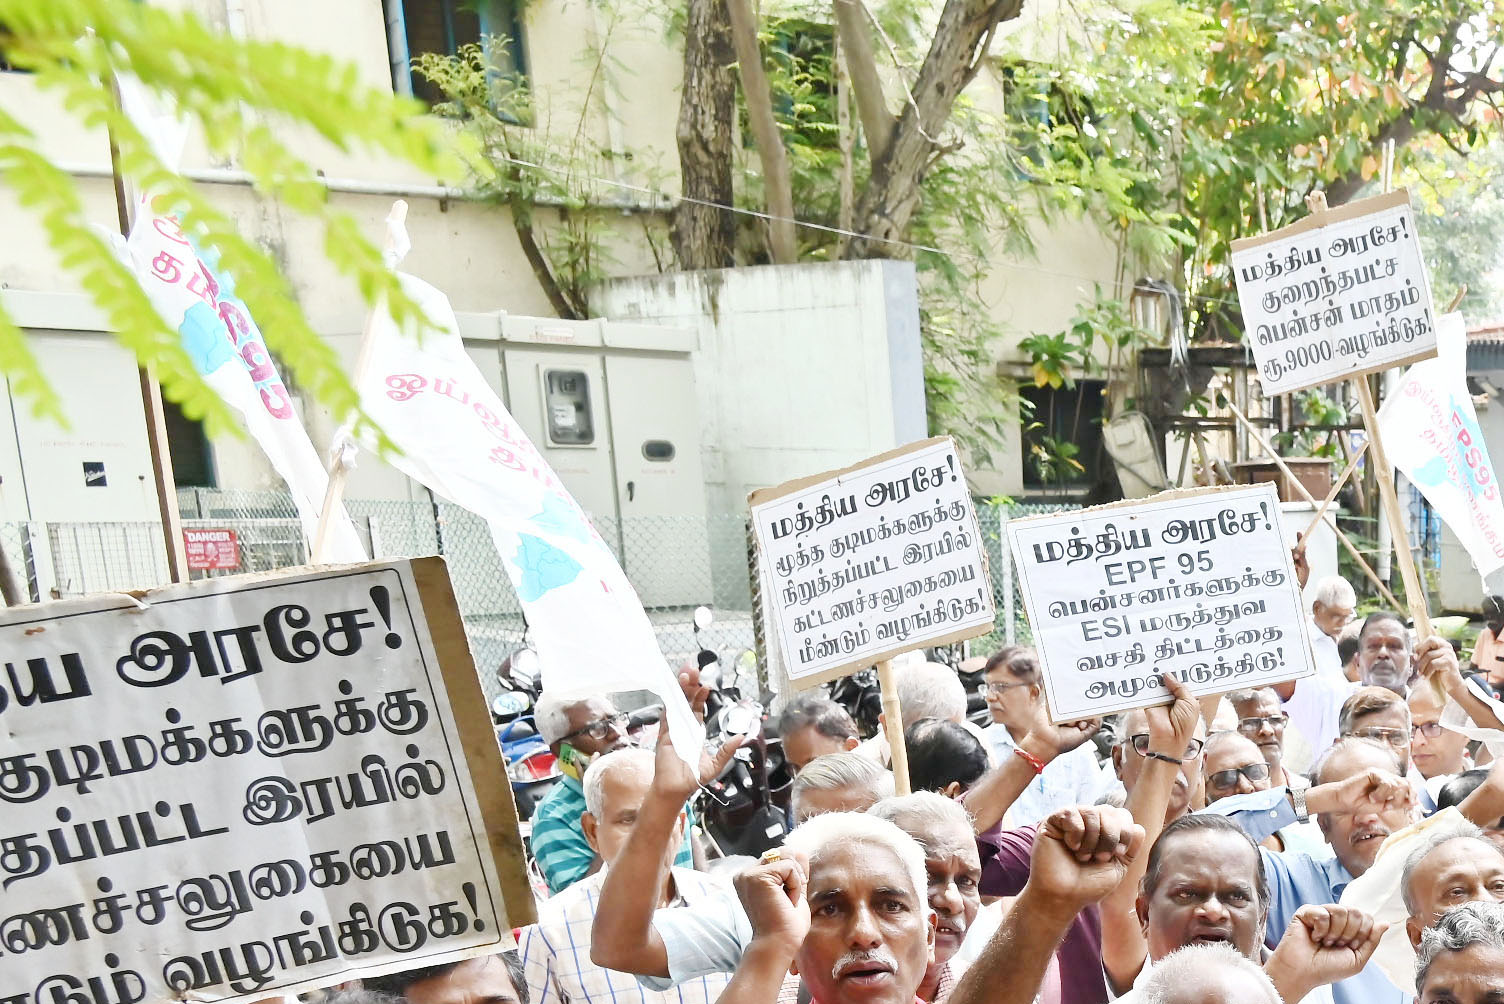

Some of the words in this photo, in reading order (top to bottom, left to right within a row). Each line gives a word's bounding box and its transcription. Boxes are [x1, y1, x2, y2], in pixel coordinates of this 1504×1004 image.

[1242, 247, 1322, 283] மத்திய
[1328, 216, 1409, 258] அரசே!
[1256, 299, 1344, 346] பென்சன்
[1350, 278, 1420, 317] மாதம்
[1262, 257, 1399, 314] குறைந்தபட்ச
[771, 494, 857, 540] மத்திய
[864, 454, 957, 508] அரசே!
[187, 531, 231, 542] DANGER
[776, 542, 824, 578] மூத்த
[830, 498, 966, 558] குடிமக்களுக்கு
[783, 555, 898, 608] நிறுத்தப்பட்ட
[903, 525, 972, 566] இரயில்
[1033, 523, 1151, 566] மத்திய
[1162, 501, 1272, 544] அரசே!
[1105, 556, 1166, 586] EPF
[1178, 550, 1214, 575] 95
[793, 563, 976, 634] கட்டணச்சலுகையை
[799, 621, 871, 664] மீண்டும்
[876, 588, 986, 643] வழங்கிடுக!
[1048, 566, 1286, 619] பென்சனர்களுக்கு
[1081, 614, 1131, 642] ESI
[1140, 599, 1266, 632] மருத்துவ
[116, 585, 402, 687] அரசே!
[1076, 642, 1145, 672] வசதி
[1154, 624, 1283, 664] திட்டத்தை
[242, 743, 446, 826] இரயில்
[0, 830, 456, 957] ணச்சலுகையை
[164, 881, 486, 994] வழங்கிடுக!
